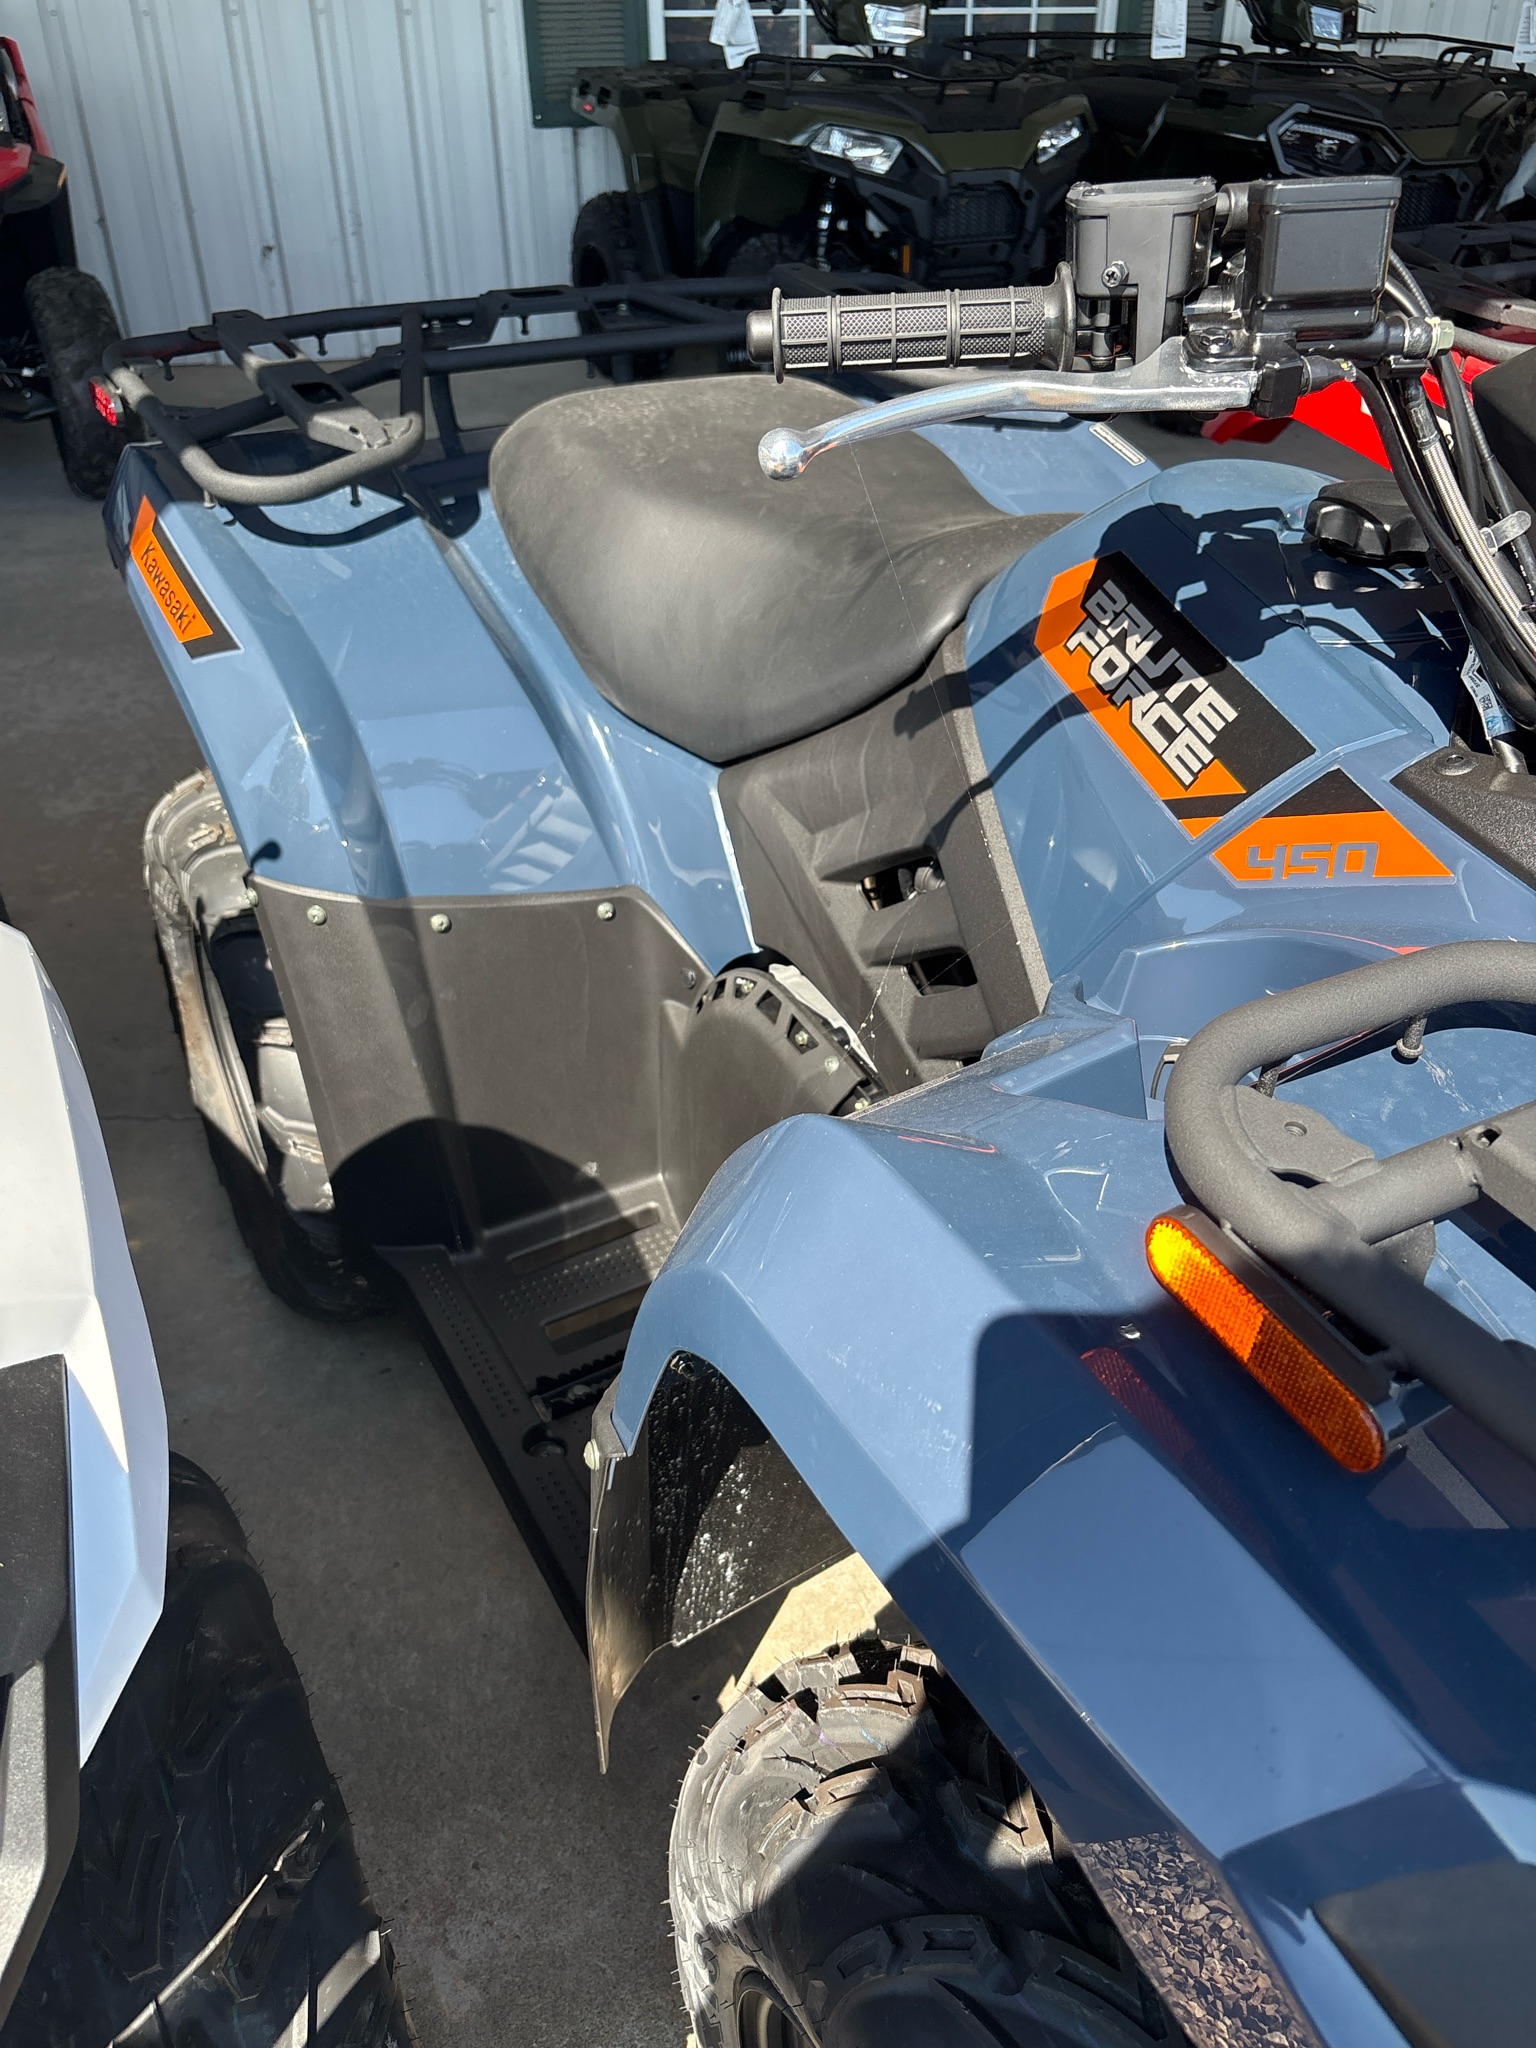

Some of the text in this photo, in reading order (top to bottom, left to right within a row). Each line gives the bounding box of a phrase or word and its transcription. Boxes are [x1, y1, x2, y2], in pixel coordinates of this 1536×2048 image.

[141, 541, 196, 634] Kawasaki
[1066, 621, 1215, 788] FORCE
[1085, 580, 1239, 744] BRUTE
[1247, 842, 1380, 880] 450
